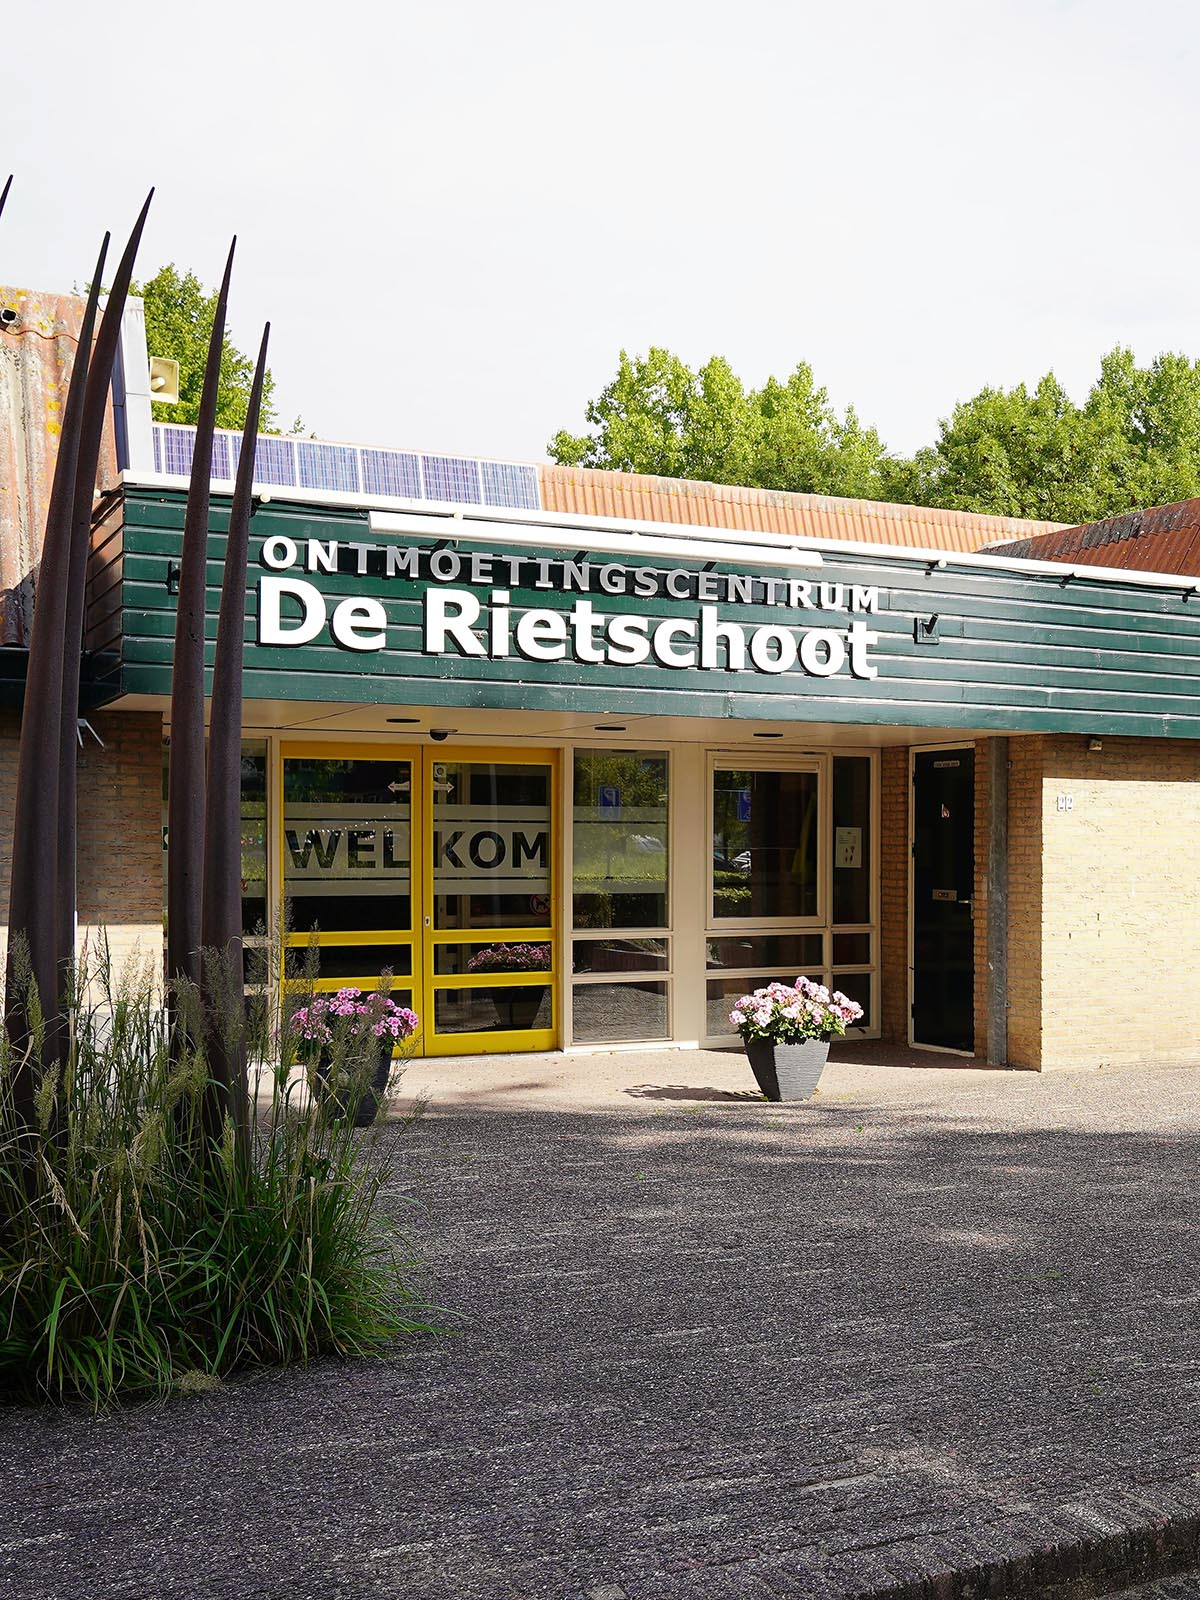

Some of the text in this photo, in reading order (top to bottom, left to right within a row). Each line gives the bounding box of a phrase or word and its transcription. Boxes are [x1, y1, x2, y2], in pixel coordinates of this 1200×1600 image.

[262, 535, 878, 613] ONTMOETINGSCENTRUM
[260, 575, 878, 679] De Rietschoot
